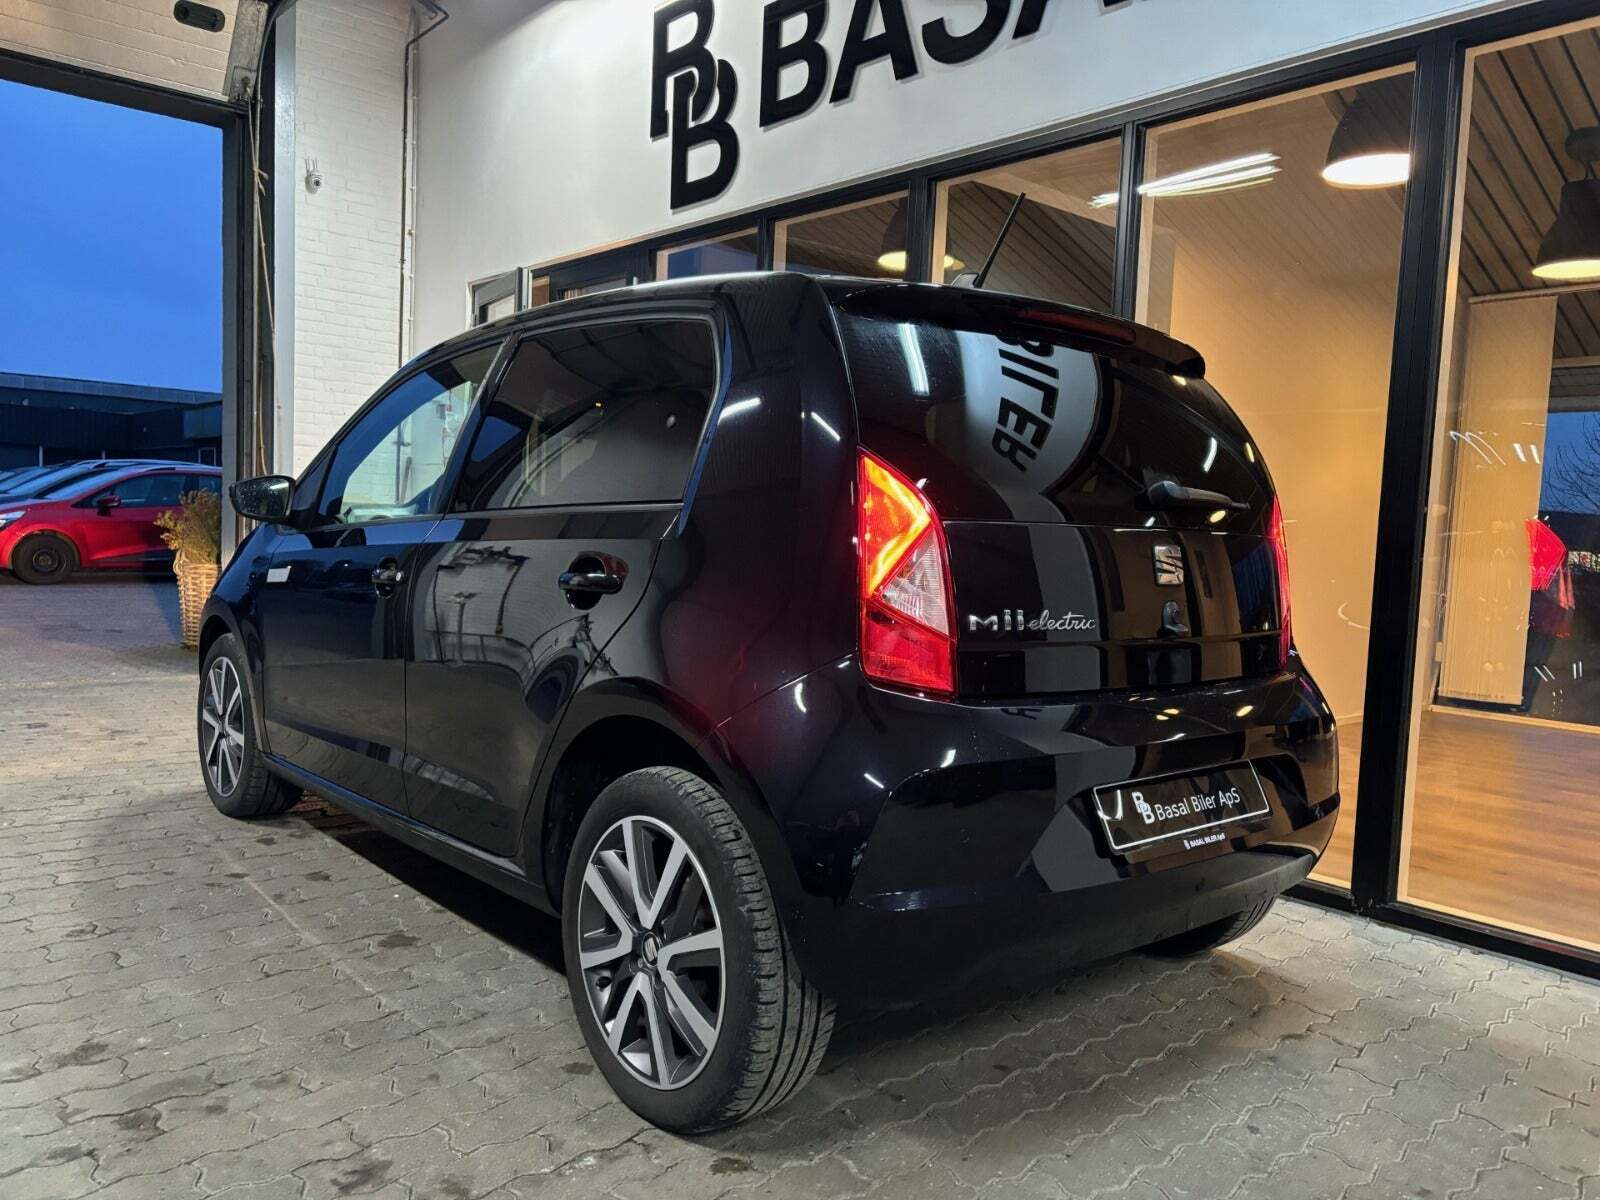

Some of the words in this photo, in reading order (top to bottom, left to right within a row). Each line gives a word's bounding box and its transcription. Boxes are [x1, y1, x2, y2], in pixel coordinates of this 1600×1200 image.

[759, 0, 1128, 127] BAS
[1026, 609, 1097, 631] electric
[1154, 798, 1190, 821] Basal
[1190, 794, 1217, 812] Biler
[1218, 787, 1240, 808] ApS
